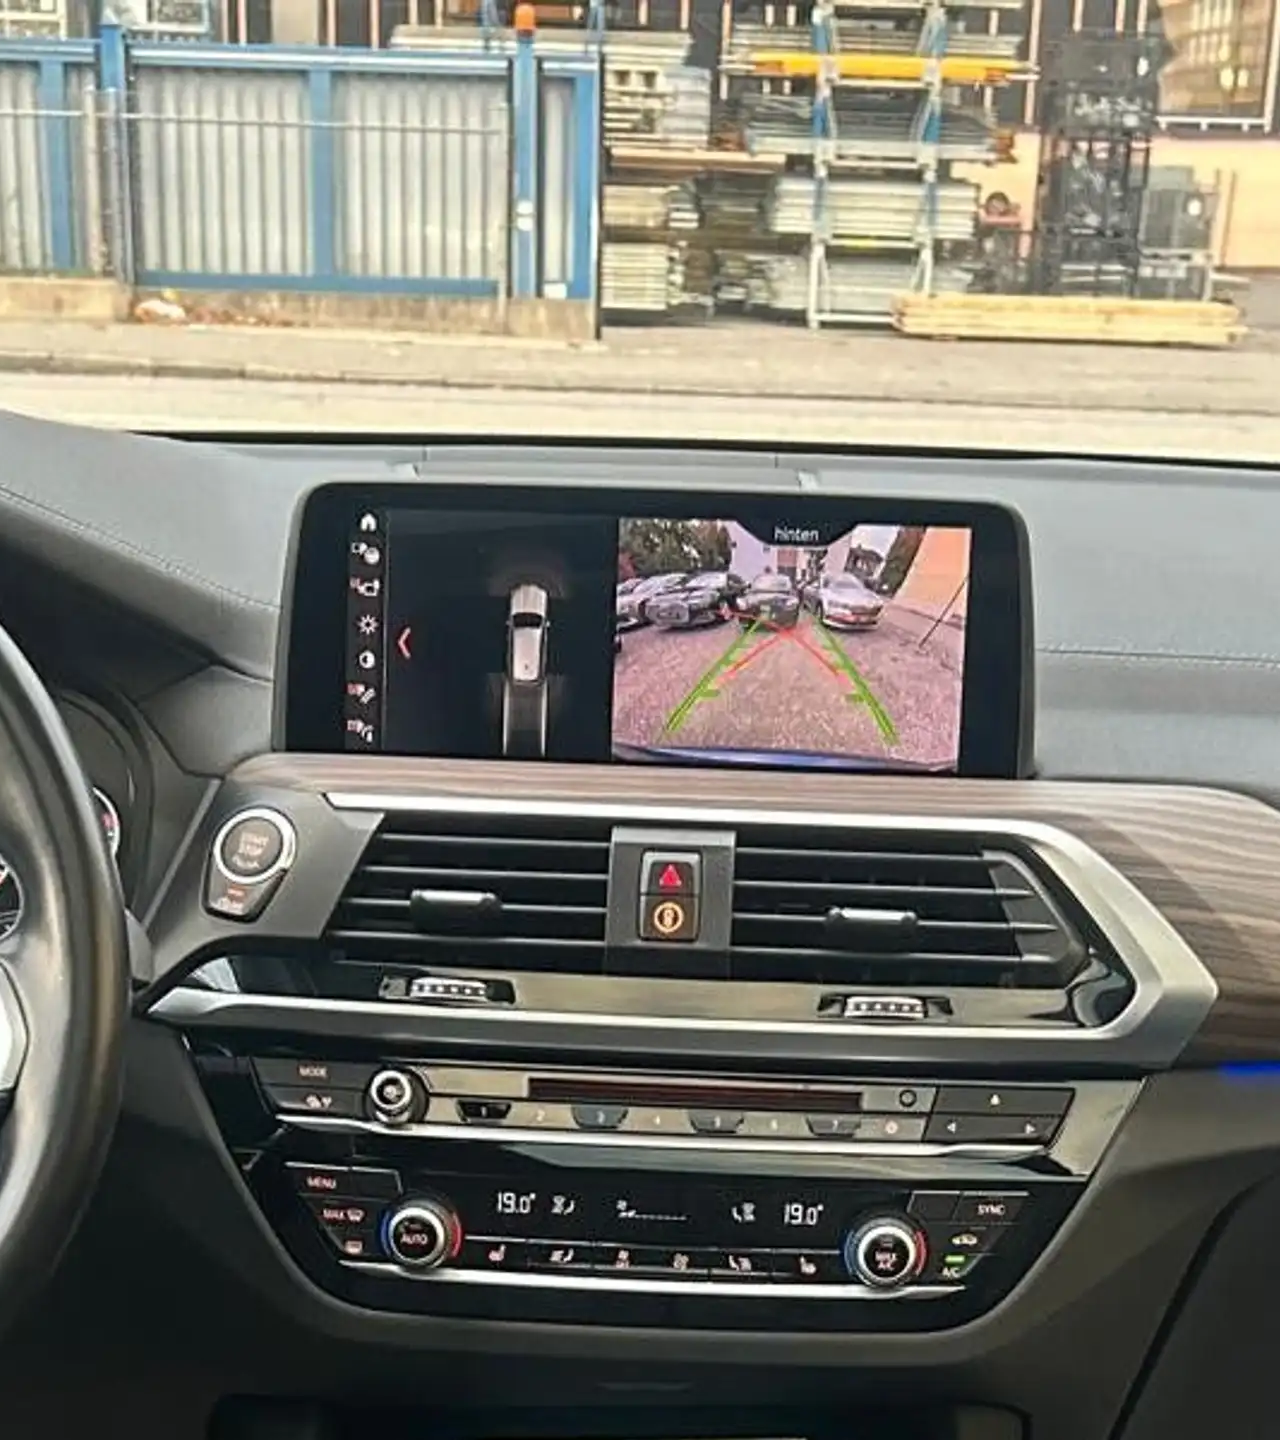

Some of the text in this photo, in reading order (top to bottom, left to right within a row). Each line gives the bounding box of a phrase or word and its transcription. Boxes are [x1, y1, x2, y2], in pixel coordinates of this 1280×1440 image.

[774, 526, 820, 542] hinten
[299, 1065, 328, 1078] MODE
[306, 1176, 337, 1189] MENU
[322, 1208, 345, 1220] MAX
[977, 1204, 1006, 1216] SYNC
[400, 1234, 428, 1245] AUTO
